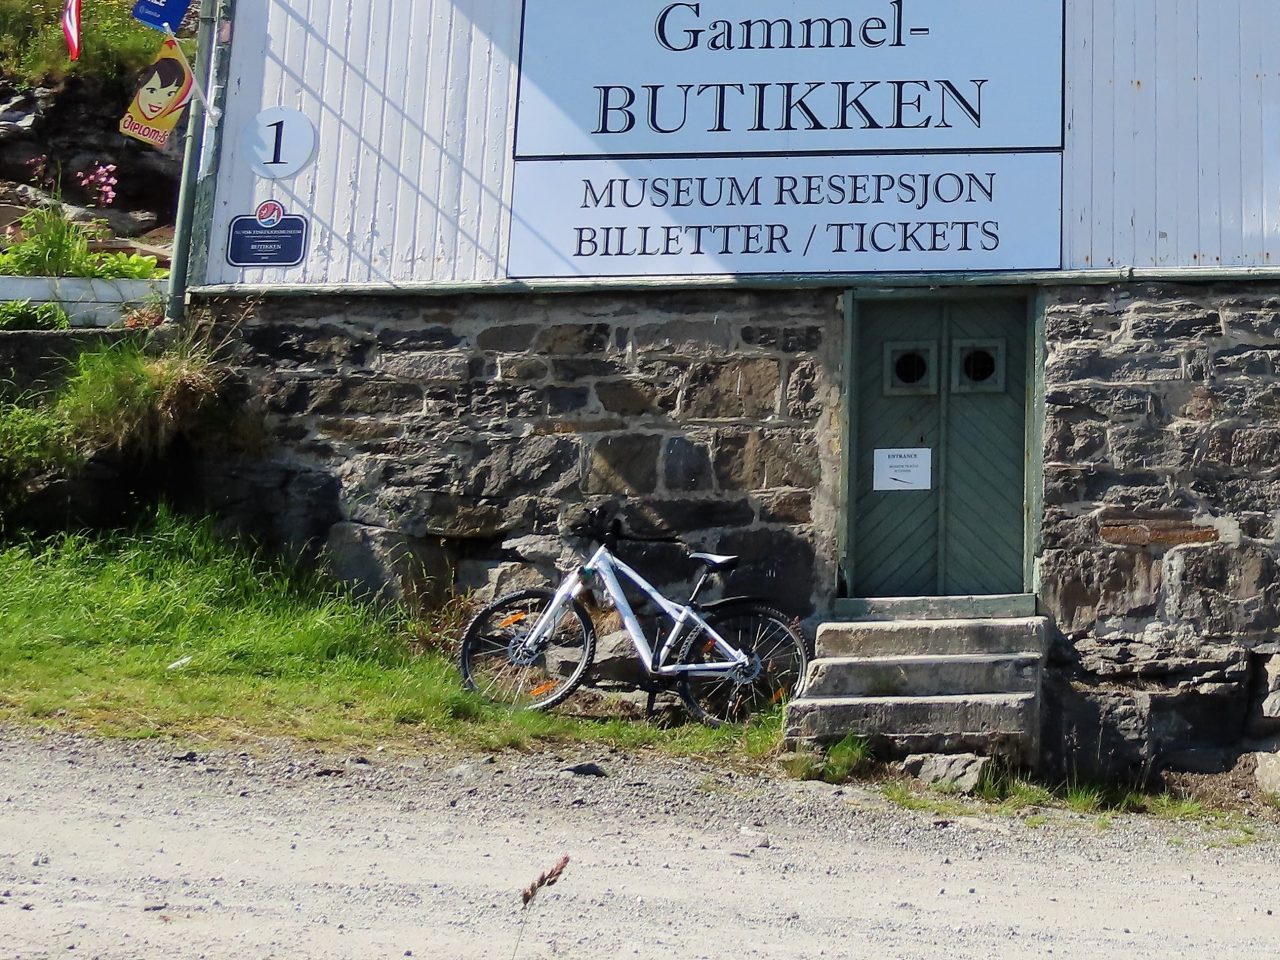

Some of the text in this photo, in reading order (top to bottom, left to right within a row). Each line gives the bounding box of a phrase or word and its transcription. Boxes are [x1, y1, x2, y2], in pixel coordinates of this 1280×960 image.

[590, 78, 989, 135] BUTIKKEN
[262, 119, 289, 165] 1
[579, 172, 997, 211] MUSEUM RESEPSJON
[572, 220, 1000, 258] BILLETTER / TICKETS
